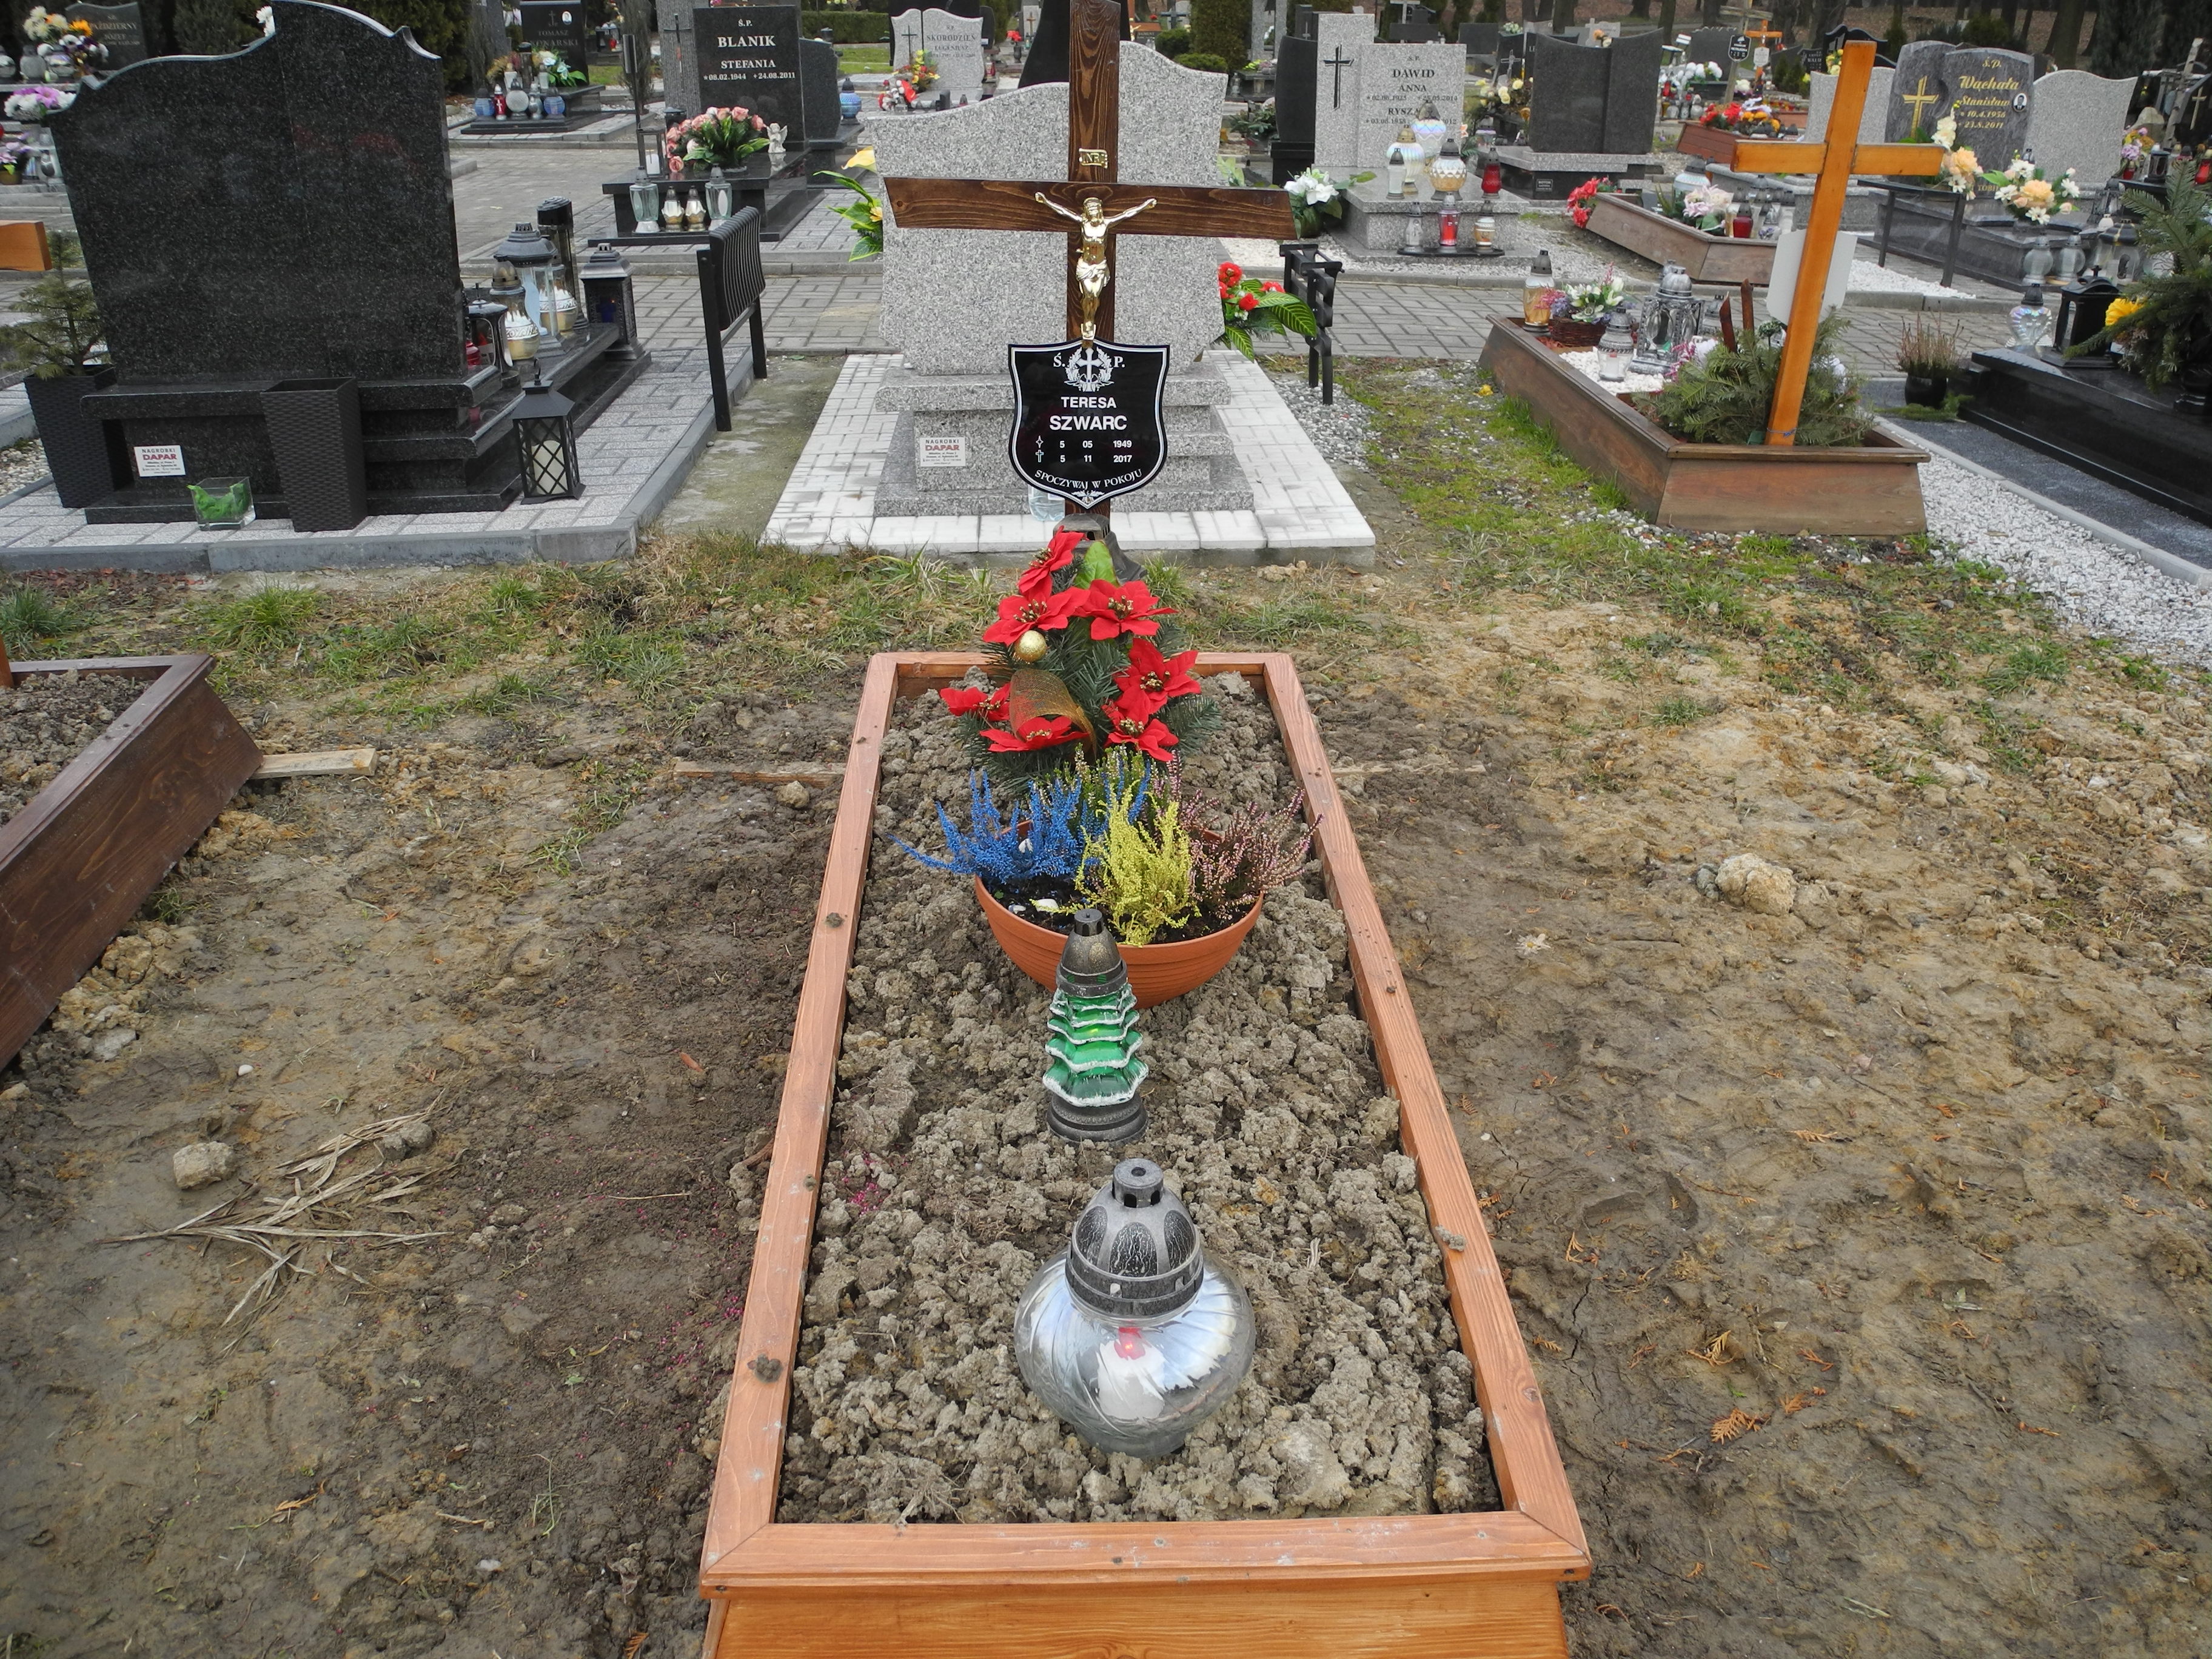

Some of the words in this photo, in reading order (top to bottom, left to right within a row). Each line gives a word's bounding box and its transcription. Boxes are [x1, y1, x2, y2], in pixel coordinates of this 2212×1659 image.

[717, 35, 776, 47] BLANIK
[721, 59, 776, 69] STEFANIA
[1392, 69, 1435, 78] DAWID
[1061, 397, 1117, 409] TERESA
[1049, 415, 1127, 431] SZWARC
[1034, 469, 1088, 491] SPOCZYWAJ
[1104, 469, 1142, 488] POKOJU
